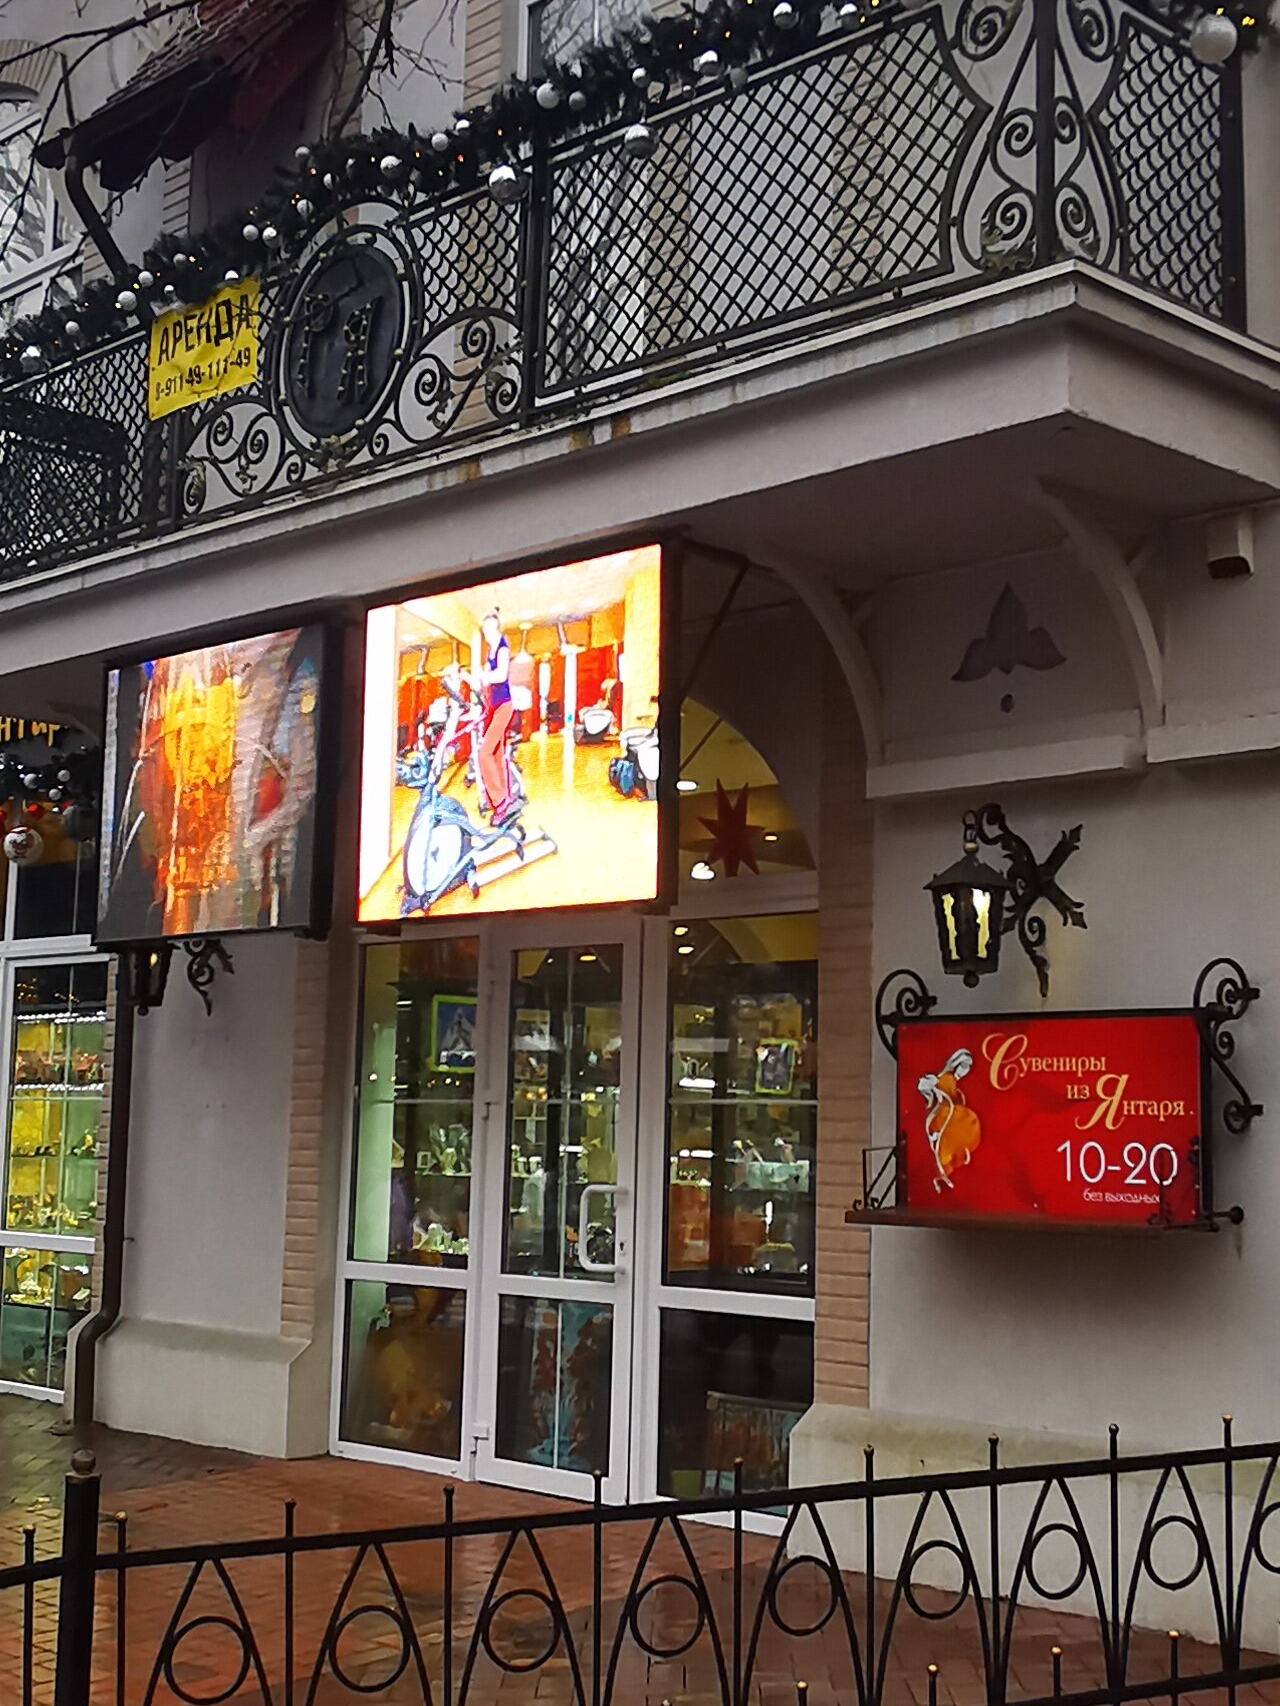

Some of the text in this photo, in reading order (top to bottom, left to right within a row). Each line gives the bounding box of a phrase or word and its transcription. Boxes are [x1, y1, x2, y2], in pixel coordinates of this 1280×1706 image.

[158, 294, 250, 366] АРЕНДА
[982, 1033, 1106, 1091] Сувениры
[1066, 1083, 1090, 1100] из
[1056, 1139, 1178, 1186] 10-20
